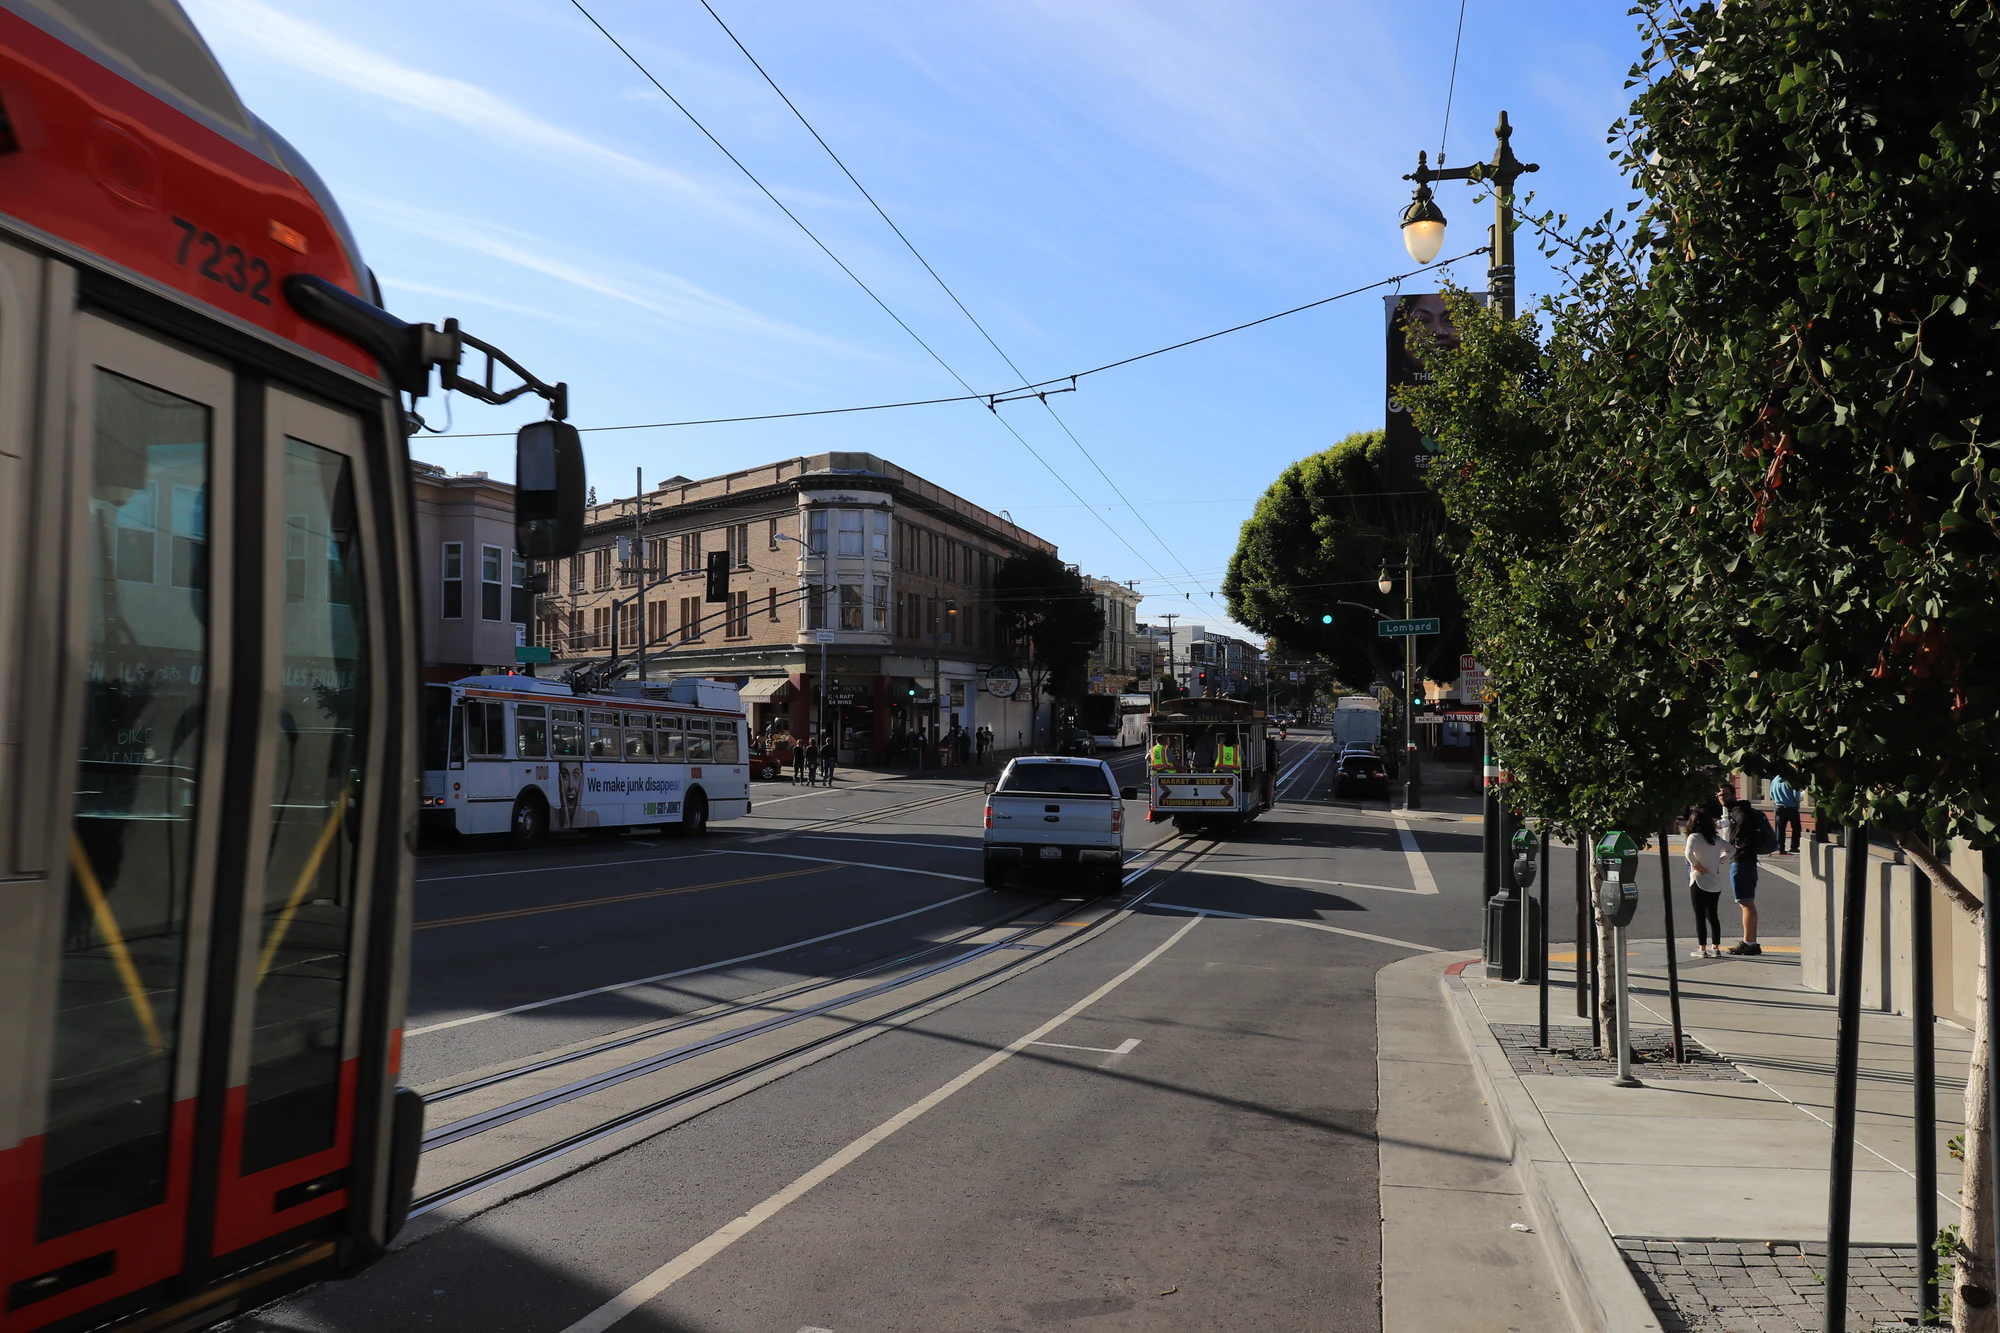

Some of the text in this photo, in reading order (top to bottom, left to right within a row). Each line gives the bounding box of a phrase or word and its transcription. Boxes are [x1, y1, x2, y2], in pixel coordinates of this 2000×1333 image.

[171, 214, 271, 306] 7232
[1386, 623, 1432, 632] Lombard
[1205, 633, 1231, 644] BIMBO'S
[1462, 657, 1473, 669] NO
[117, 726, 153, 745] BIKE
[588, 777, 683, 796] We make junk disappear.
[1193, 788, 1199, 797] 1
